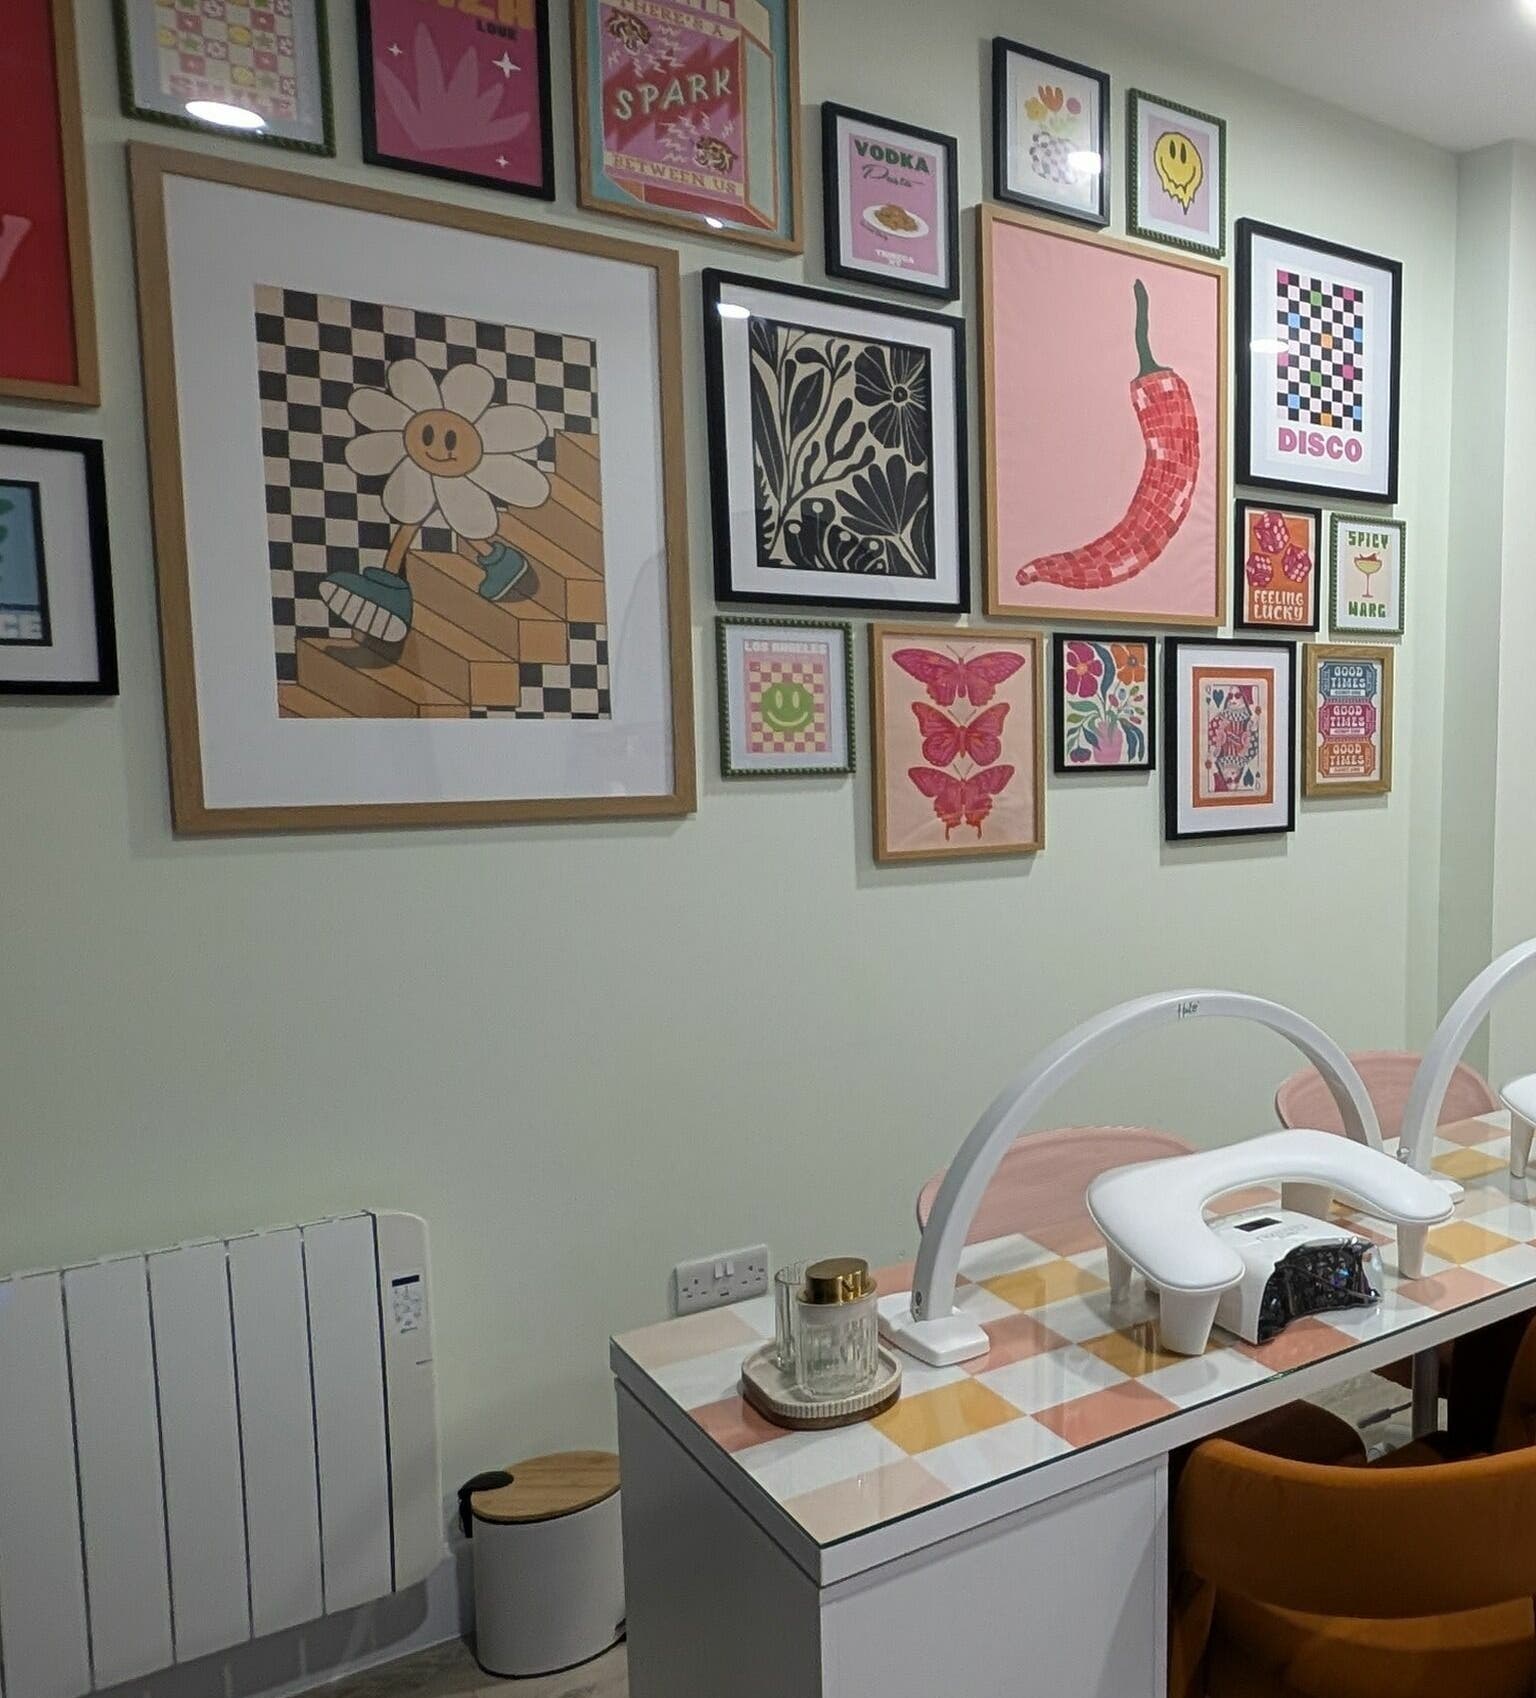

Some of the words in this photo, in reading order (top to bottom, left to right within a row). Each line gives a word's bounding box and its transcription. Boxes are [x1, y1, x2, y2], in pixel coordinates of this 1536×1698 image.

[476, 19, 518, 40] LOVE
[712, 23, 723, 37] A
[615, 68, 732, 120] SPARK
[854, 139, 929, 173] VODKA
[614, 158, 705, 187] BETWEEN
[714, 180, 736, 193] US
[1279, 427, 1362, 462] DISCO
[1348, 531, 1389, 549] SPICY
[1254, 590, 1304, 605] FEELING
[1254, 605, 1304, 621] LUCKY
[1349, 601, 1386, 617] MARG
[744, 640, 769, 652] LOS
[1334, 666, 1363, 677] GOOD
[1330, 677, 1366, 688] TIMES
[1333, 705, 1363, 716] GOOD
[1330, 716, 1365, 727] TIMES
[1332, 744, 1362, 754] GOOD
[1329, 755, 1365, 766] TIMES
